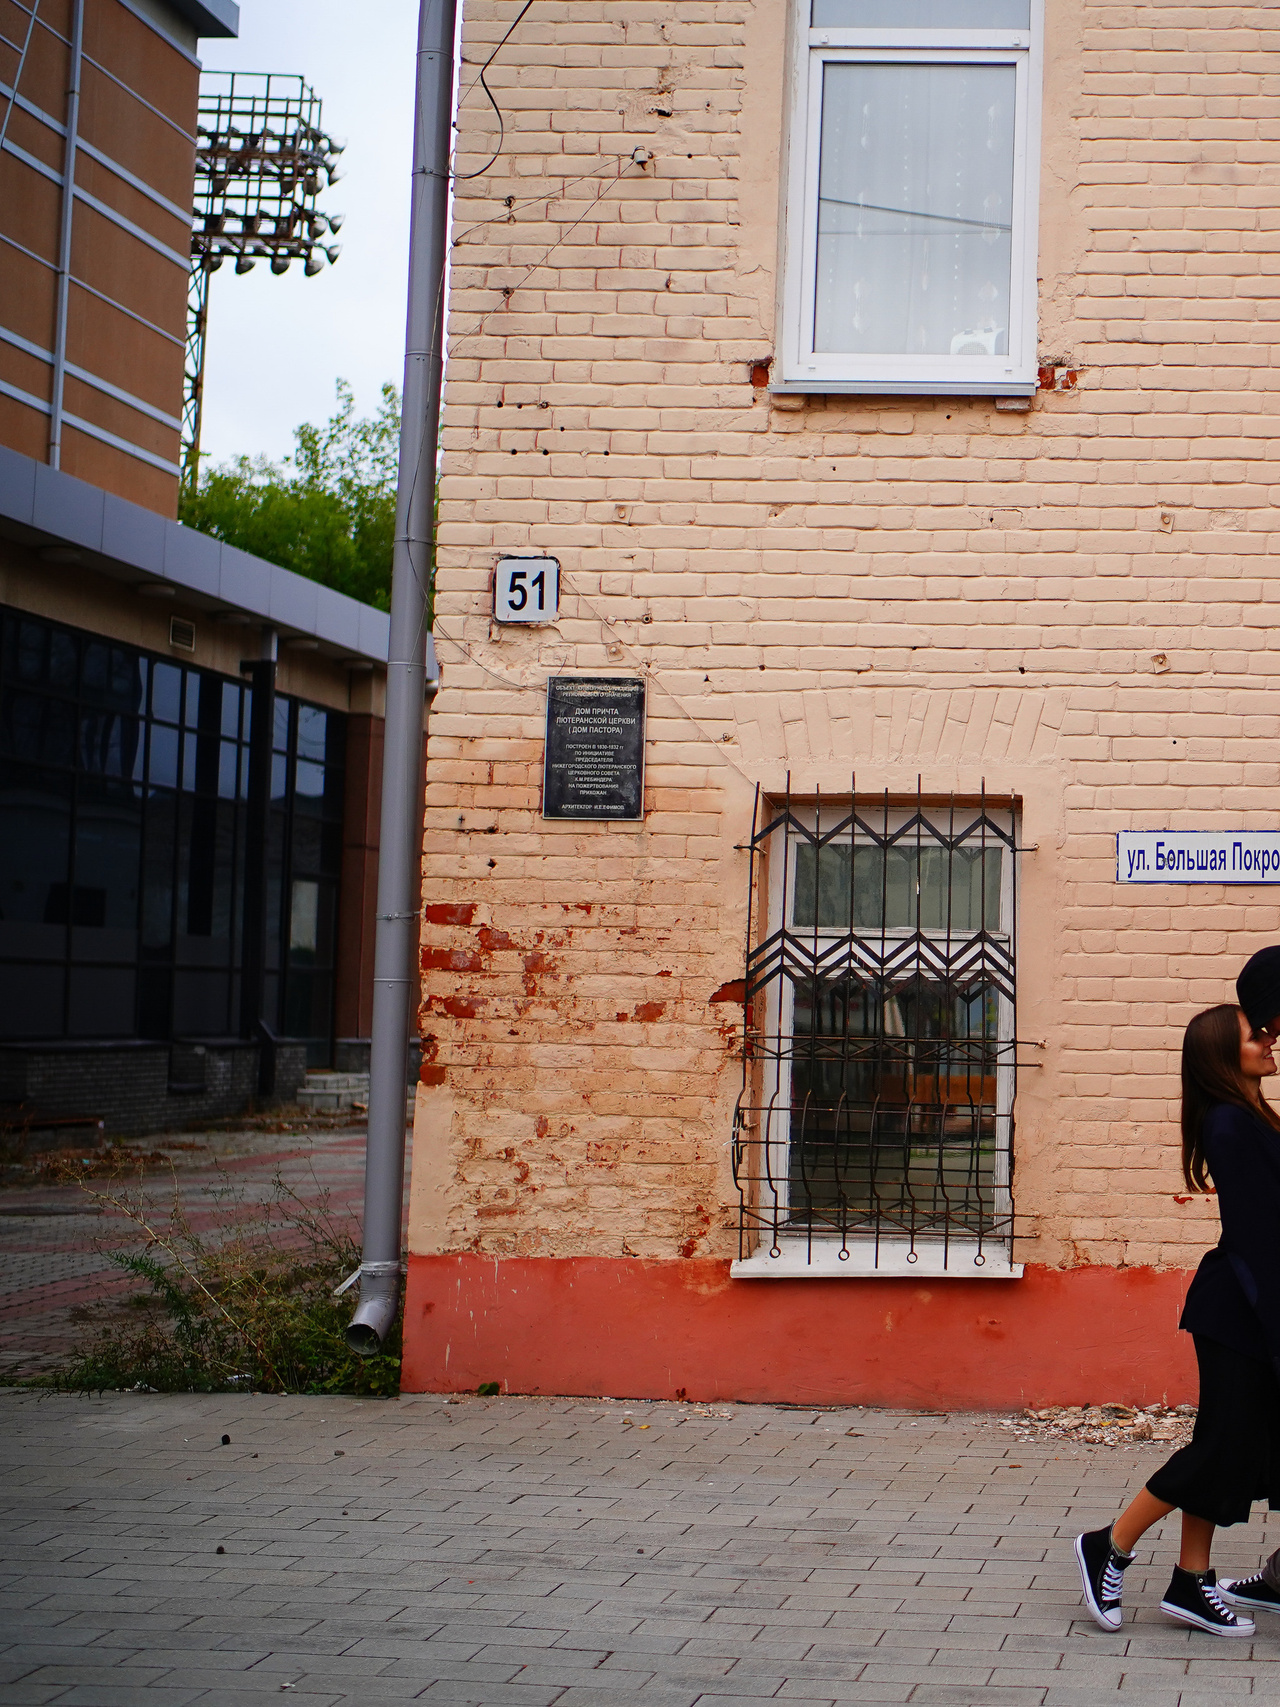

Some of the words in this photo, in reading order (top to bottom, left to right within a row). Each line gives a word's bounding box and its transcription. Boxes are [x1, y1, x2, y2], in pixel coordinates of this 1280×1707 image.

[507, 571, 545, 611] 51
[556, 716, 607, 724] ЛЮТЕРАНСКОЙ
[608, 717, 636, 725] ЦЕРКВИ
[575, 707, 591, 715] ДОМ
[1127, 849, 1150, 878] ул.
[1155, 841, 1226, 871] Большая
